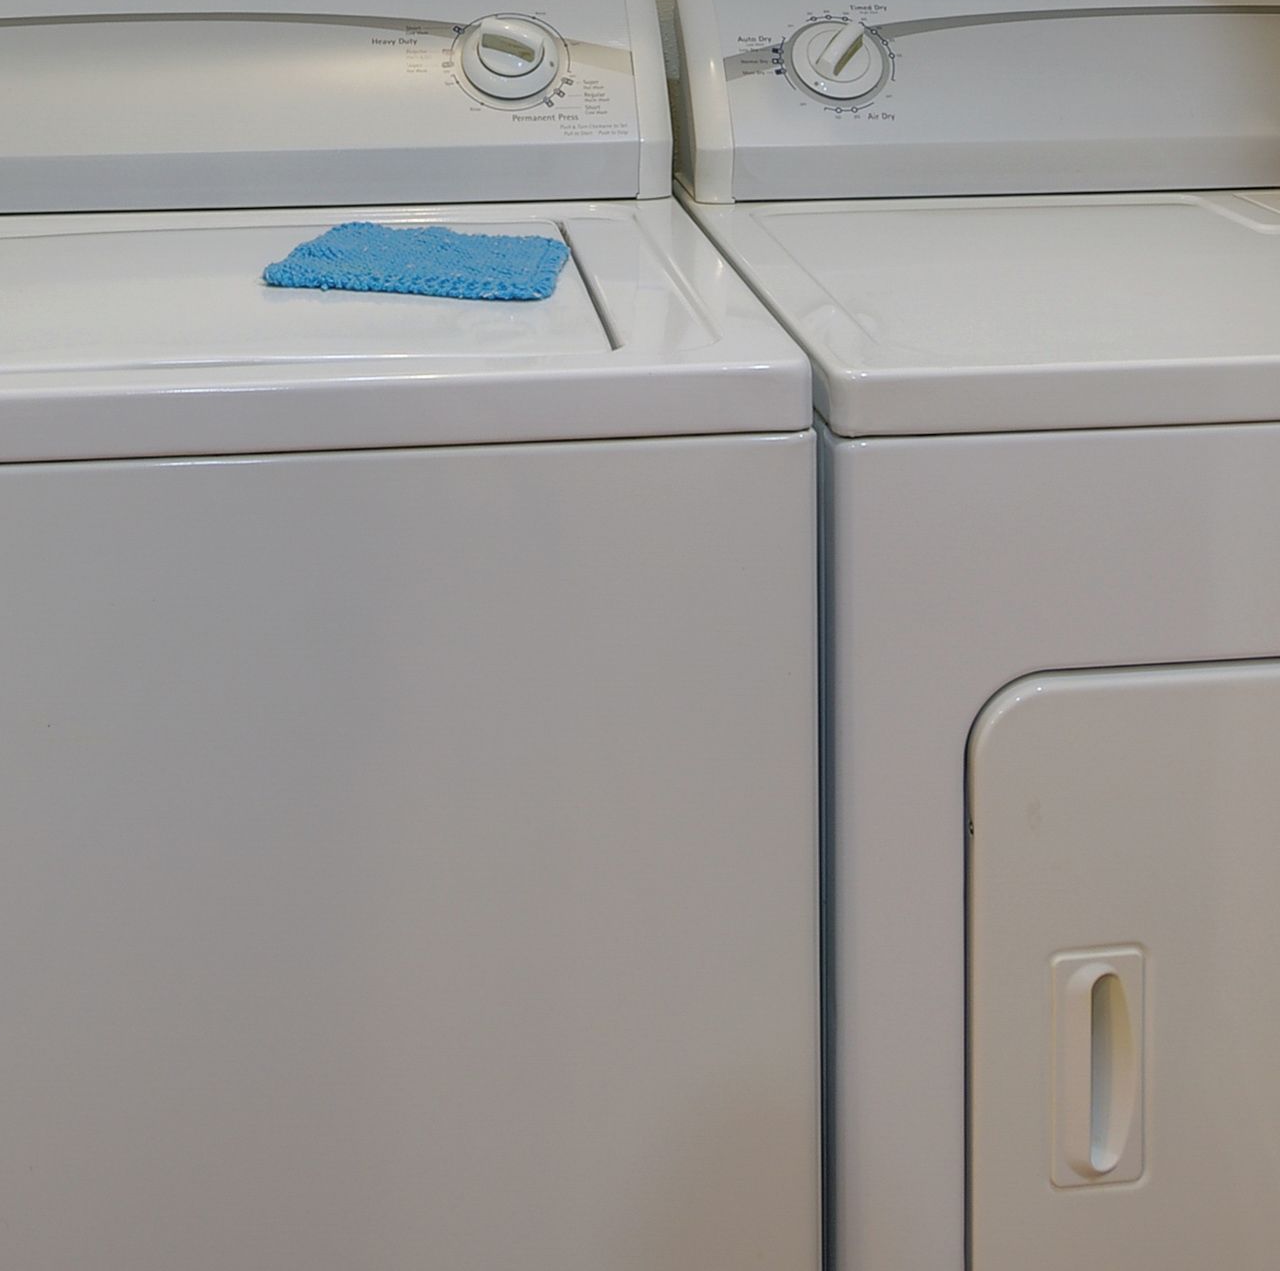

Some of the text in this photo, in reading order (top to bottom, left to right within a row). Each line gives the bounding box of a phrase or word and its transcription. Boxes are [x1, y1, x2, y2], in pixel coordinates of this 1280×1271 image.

[371, 38, 396, 46] Heavy
[758, 35, 772, 43] Dry
[512, 113, 579, 122] Permanent Press
[867, 112, 879, 120] Air
[881, 112, 895, 121] Dry
